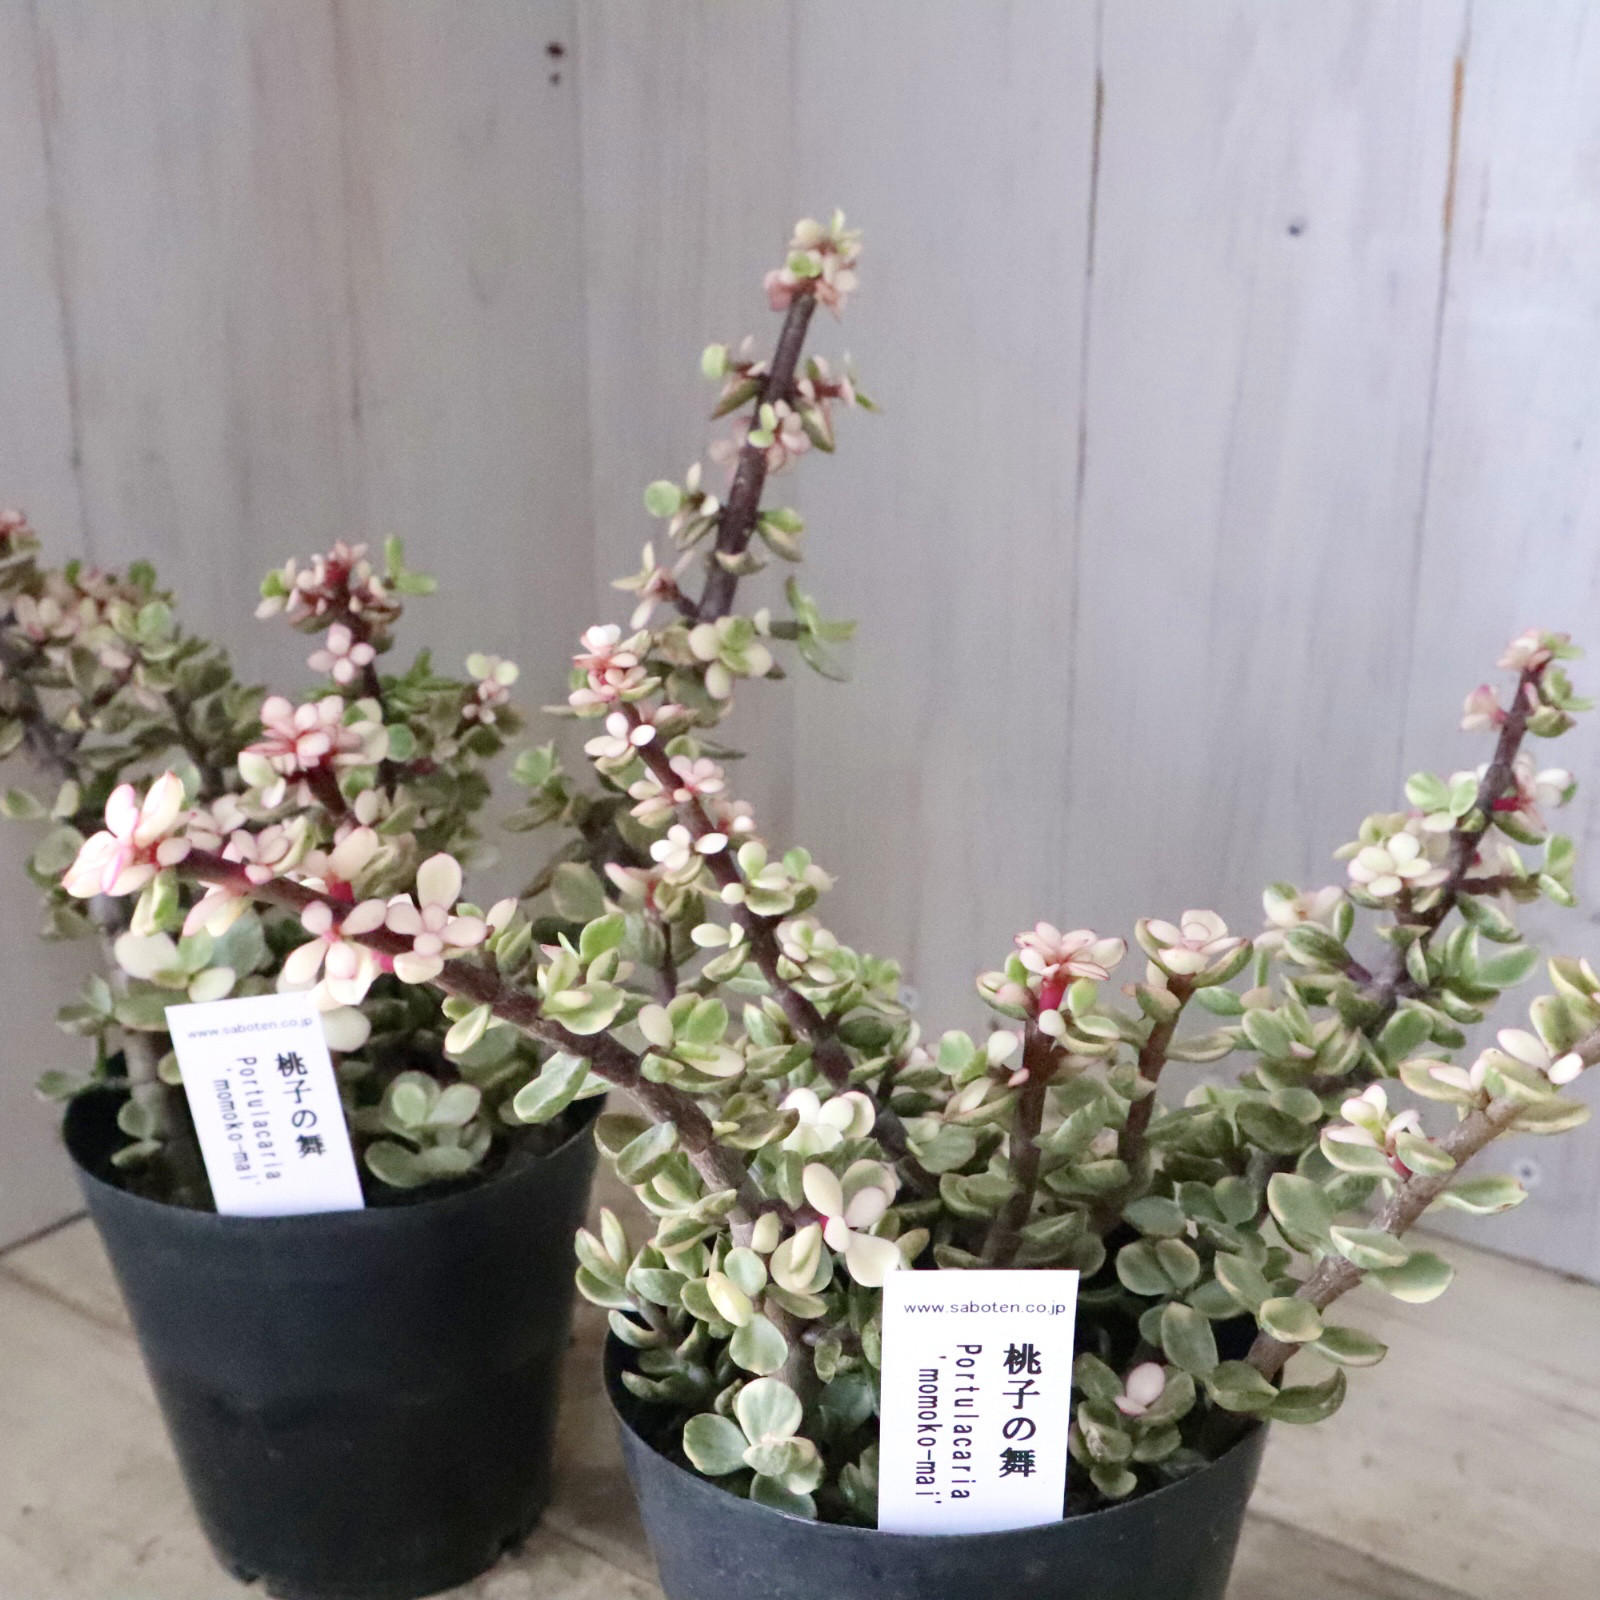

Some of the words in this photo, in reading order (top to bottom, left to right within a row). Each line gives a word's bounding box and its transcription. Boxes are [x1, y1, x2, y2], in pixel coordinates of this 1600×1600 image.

[186, 1017, 313, 1039] www.saboten.co.jp
[236, 1056, 283, 1180] Portulacaria
[274, 1051, 327, 1158] 桃子の舞
[904, 1300, 1066, 1316] www.saboten.co.jp
[915, 1355, 947, 1504] 'momoko-mai'
[950, 1344, 983, 1499] Portulacaria
[999, 1343, 1042, 1478] 桃子の舞
